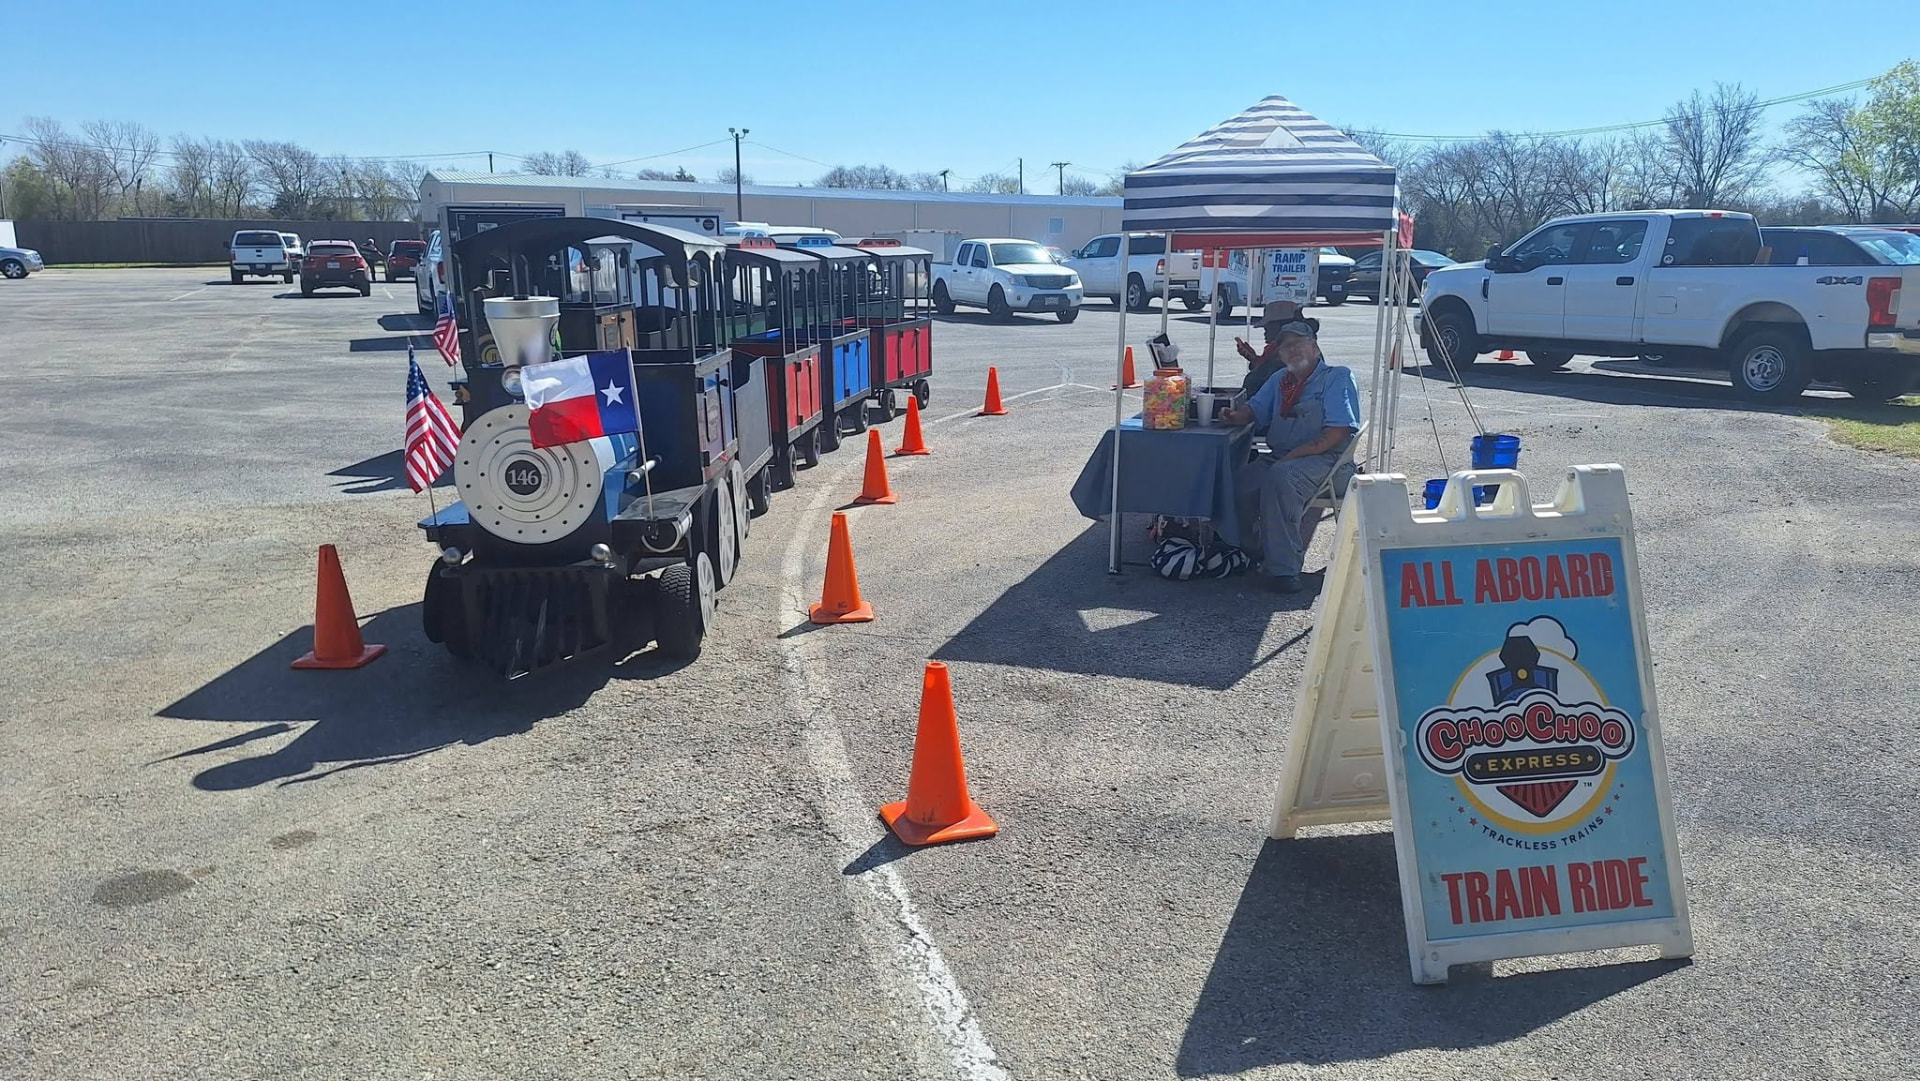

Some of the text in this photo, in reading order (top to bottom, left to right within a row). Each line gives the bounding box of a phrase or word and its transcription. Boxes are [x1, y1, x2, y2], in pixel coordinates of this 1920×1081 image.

[1272, 264, 1306, 273] TRAILER
[1274, 253, 1306, 264] RAMP
[507, 469, 540, 486] 146
[1401, 552, 1615, 608] ALL ABOARD
[1487, 752, 1582, 772] EXPRESS
[1481, 816, 1604, 850] TRACKLESS TRAINS
[1441, 856, 1653, 925] TRAIN RIDE
